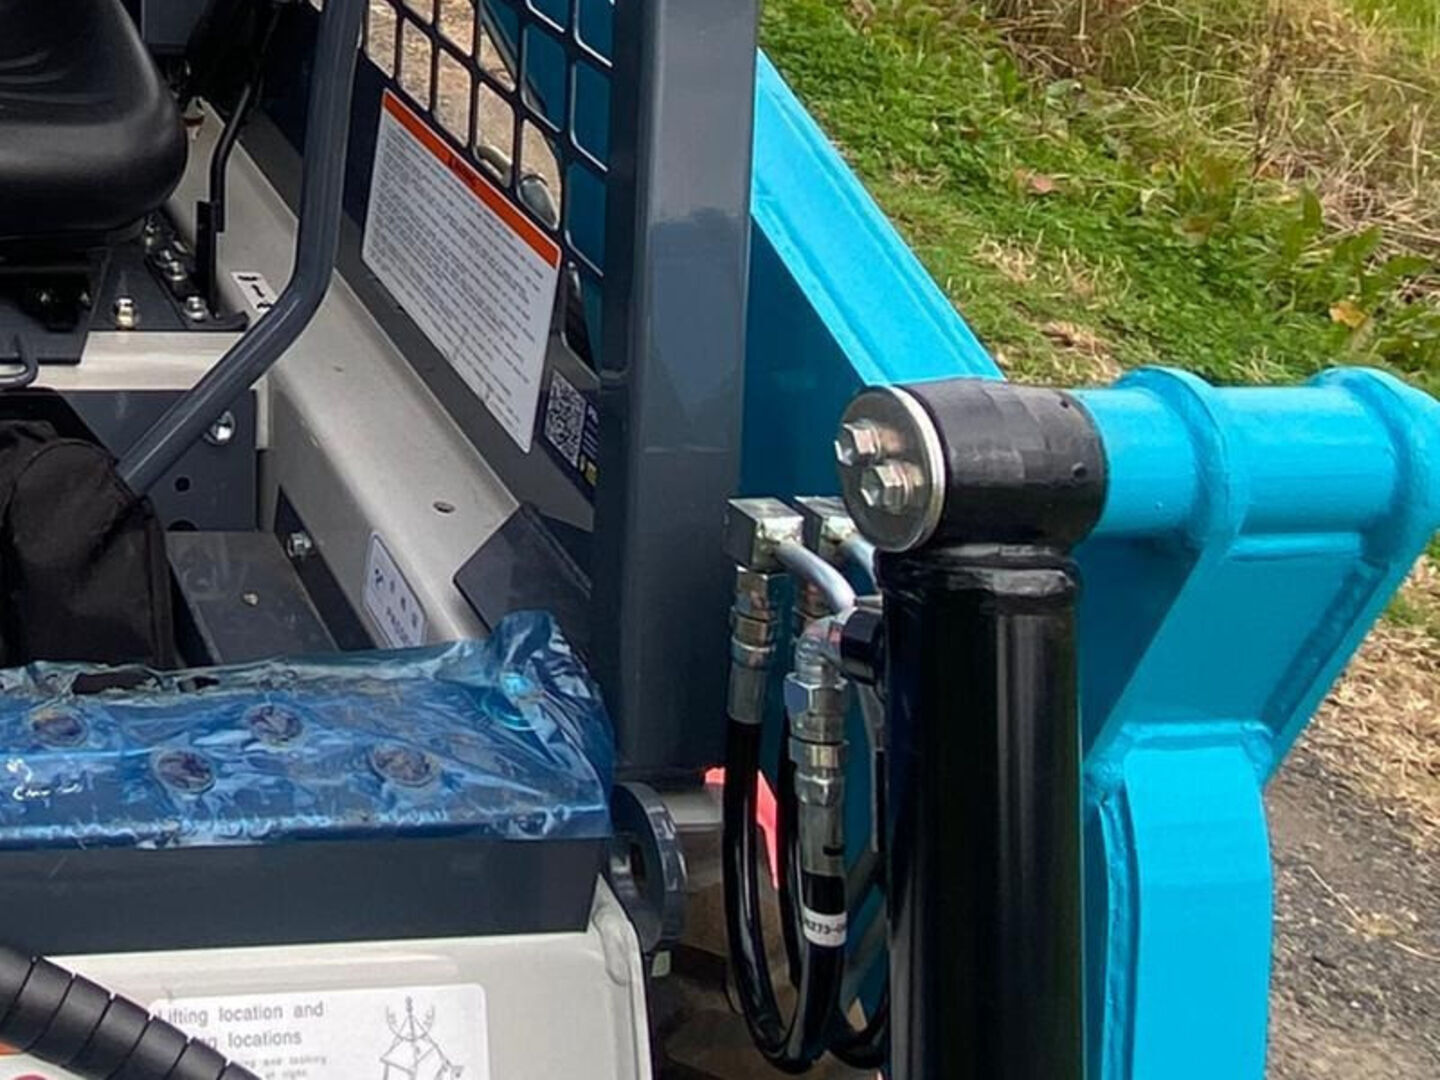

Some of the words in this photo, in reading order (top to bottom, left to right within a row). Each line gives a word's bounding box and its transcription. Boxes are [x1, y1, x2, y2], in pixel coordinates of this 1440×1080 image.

[218, 1005, 284, 1023] location
[293, 1001, 324, 1018] and
[227, 1030, 302, 1048] locations
